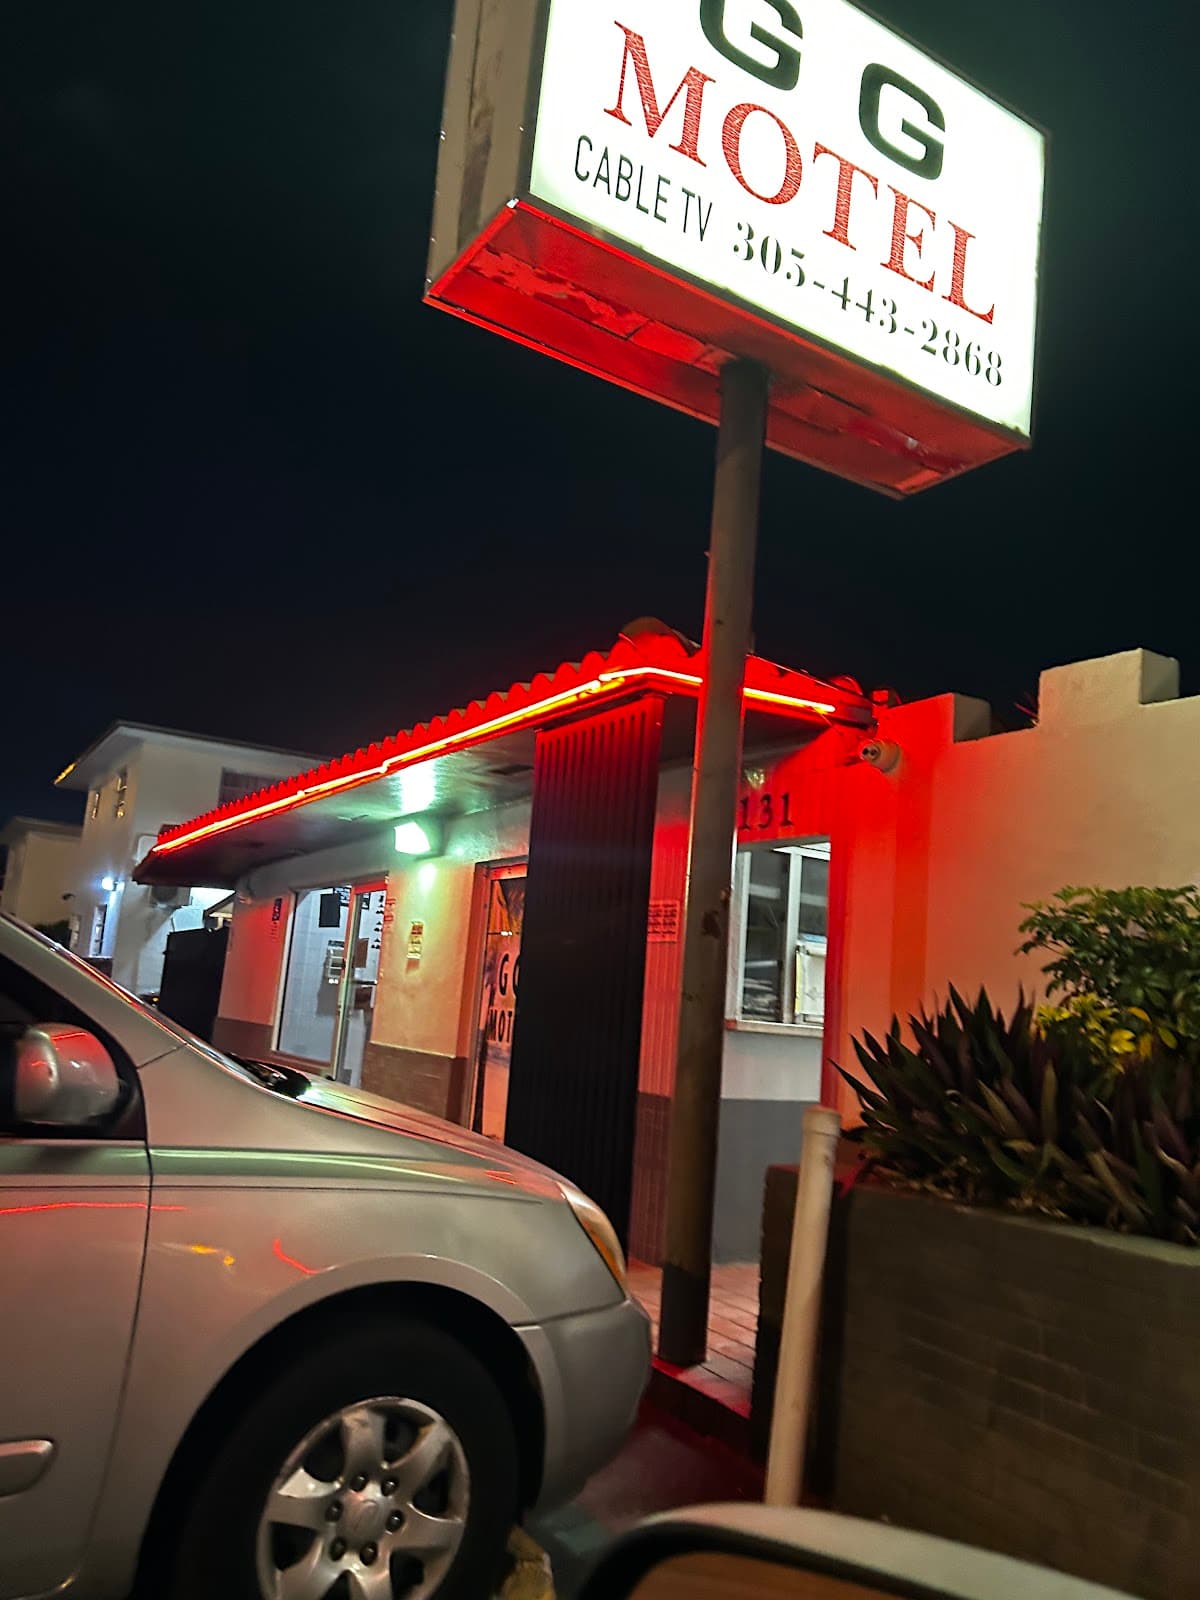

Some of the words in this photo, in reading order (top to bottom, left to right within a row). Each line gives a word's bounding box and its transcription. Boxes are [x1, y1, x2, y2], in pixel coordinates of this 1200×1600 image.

[603, 20, 995, 325] MOTEL
[700, 0, 804, 91] G
[858, 62, 946, 181] G
[574, 134, 671, 224] CABLE
[681, 187, 713, 242] TV
[733, 221, 1002, 387] 305-443-2868
[738, 792, 794, 830] 131
